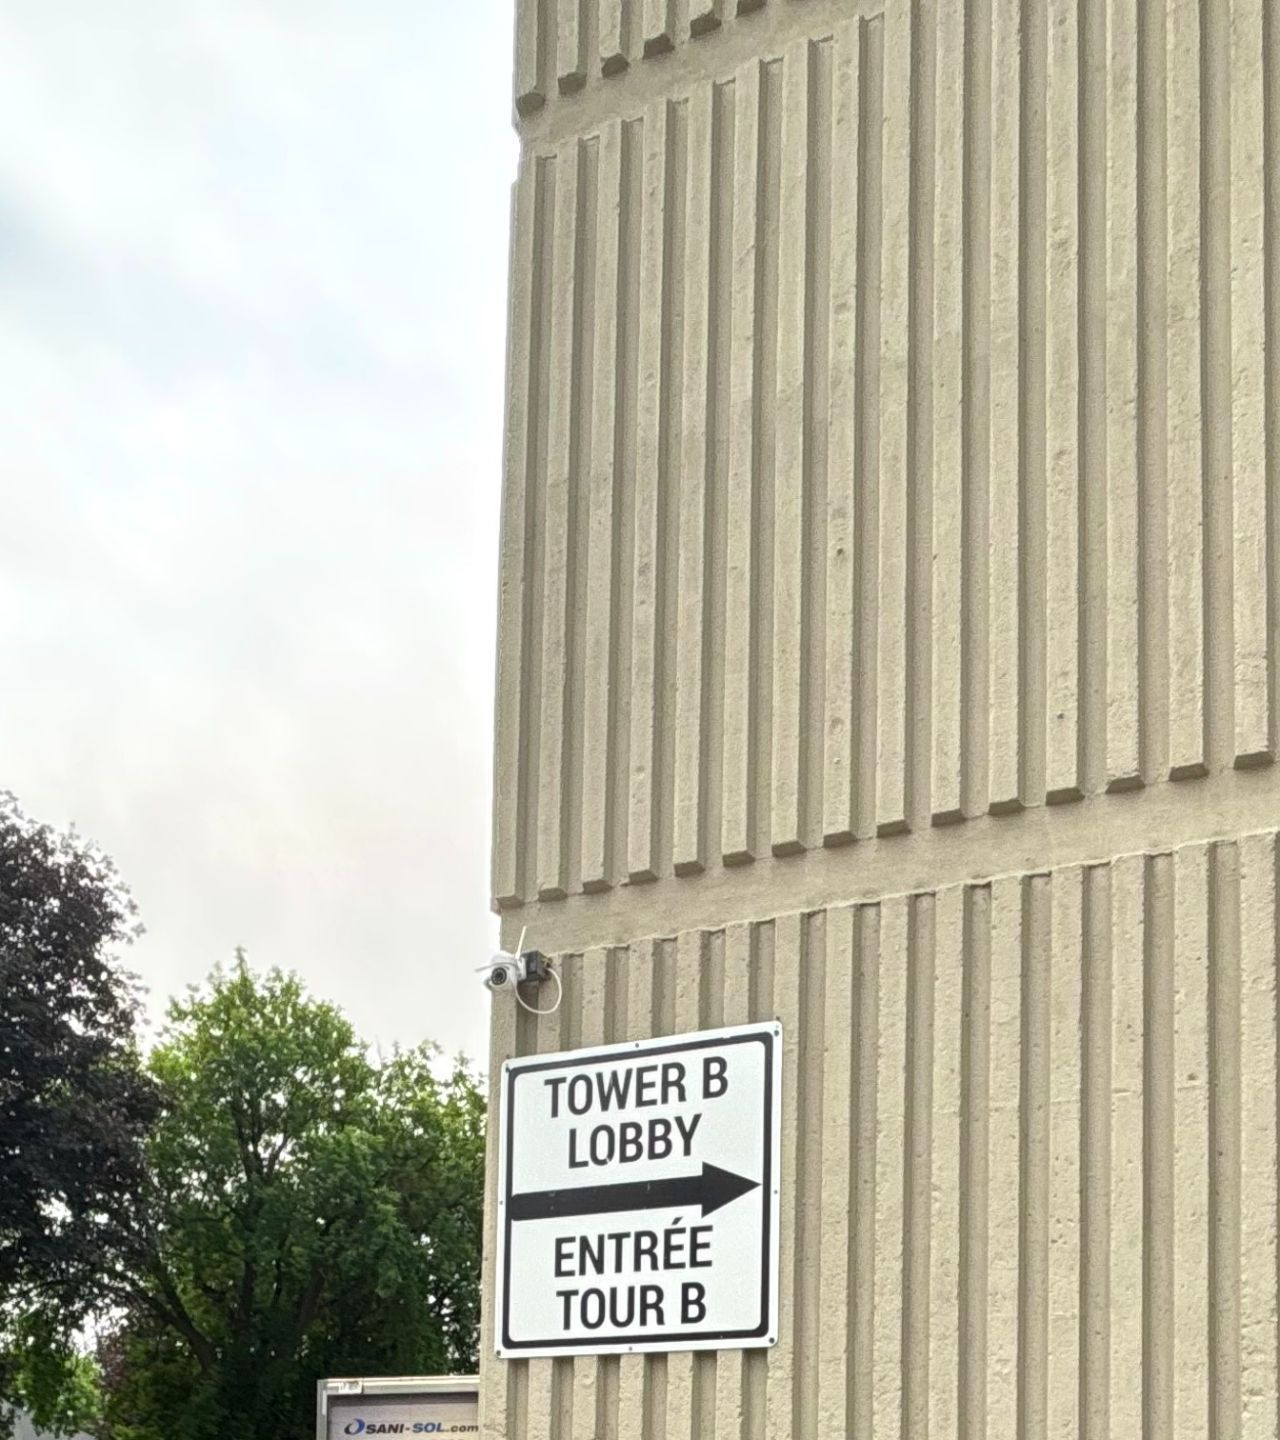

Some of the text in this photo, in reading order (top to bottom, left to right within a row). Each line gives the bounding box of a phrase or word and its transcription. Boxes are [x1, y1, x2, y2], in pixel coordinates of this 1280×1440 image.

[544, 1056, 728, 1118] TOWER B
[568, 1113, 703, 1169] LOBBY
[554, 1216, 714, 1278] ENTRÉE
[556, 1281, 707, 1330] TOUR B
